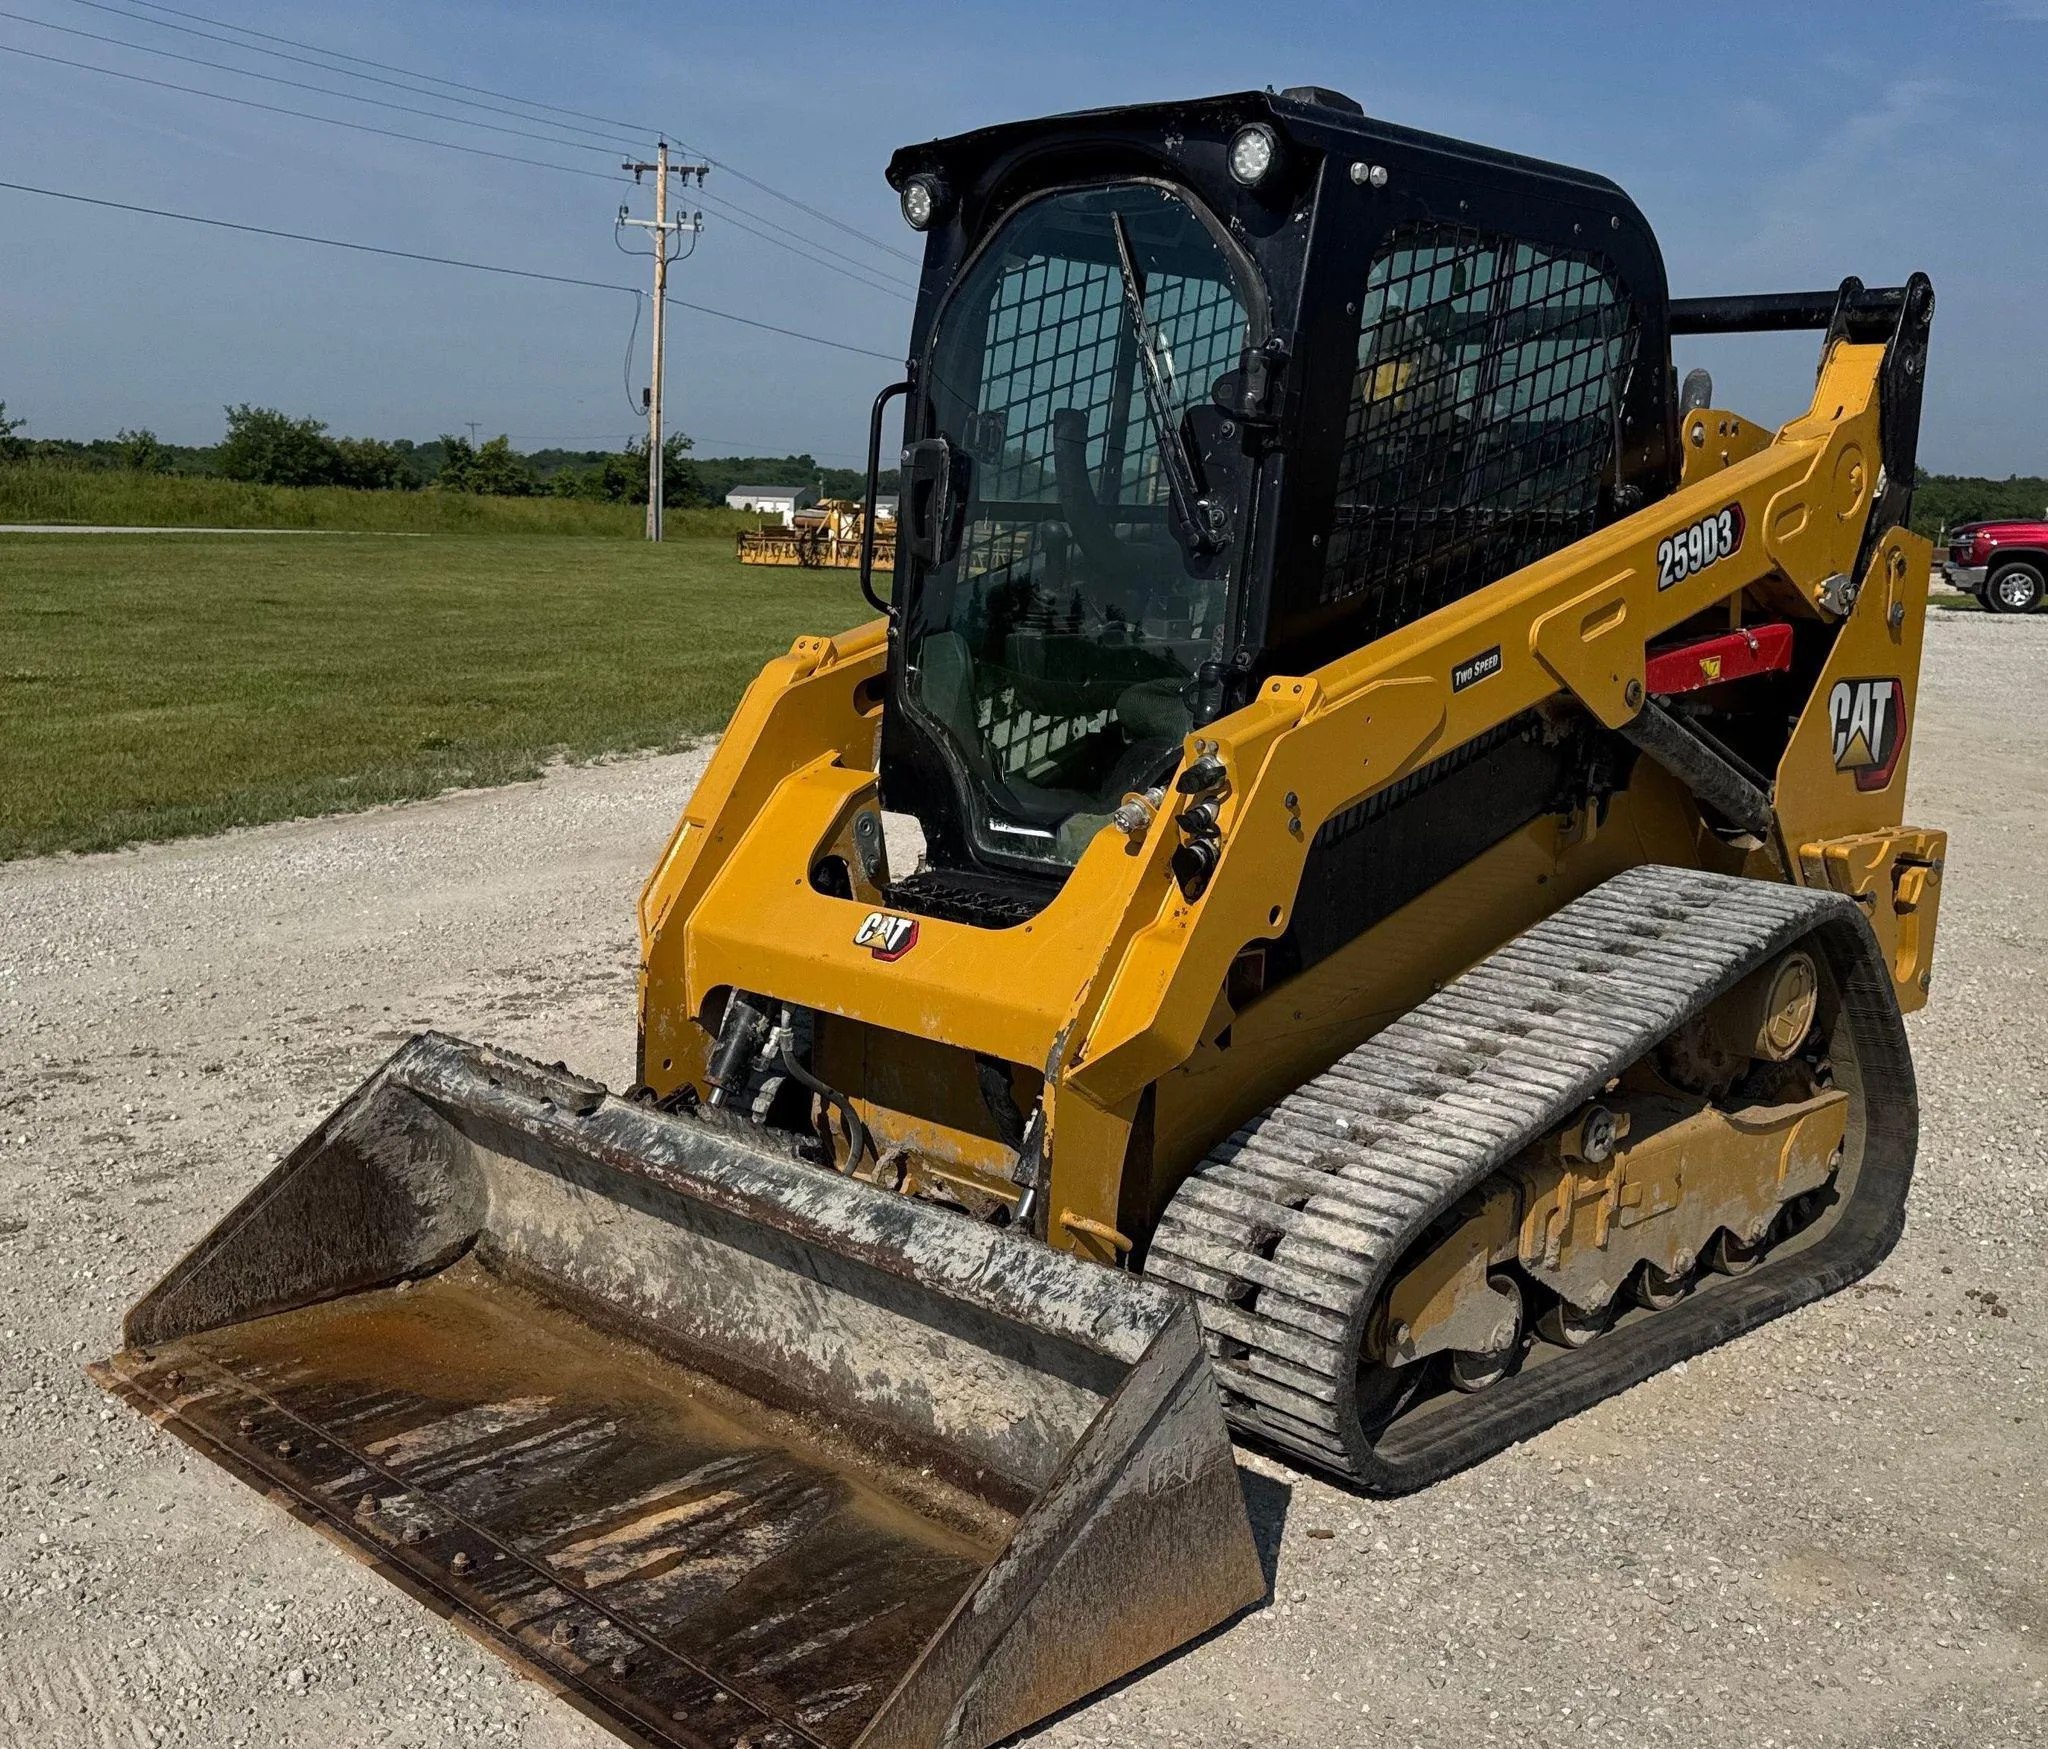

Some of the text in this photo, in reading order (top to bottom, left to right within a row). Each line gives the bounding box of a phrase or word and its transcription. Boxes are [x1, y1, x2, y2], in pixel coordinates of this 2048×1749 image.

[1658, 510, 1732, 589] 259D3
[1829, 681, 1893, 766] CAT
[854, 912, 914, 951] CAT
